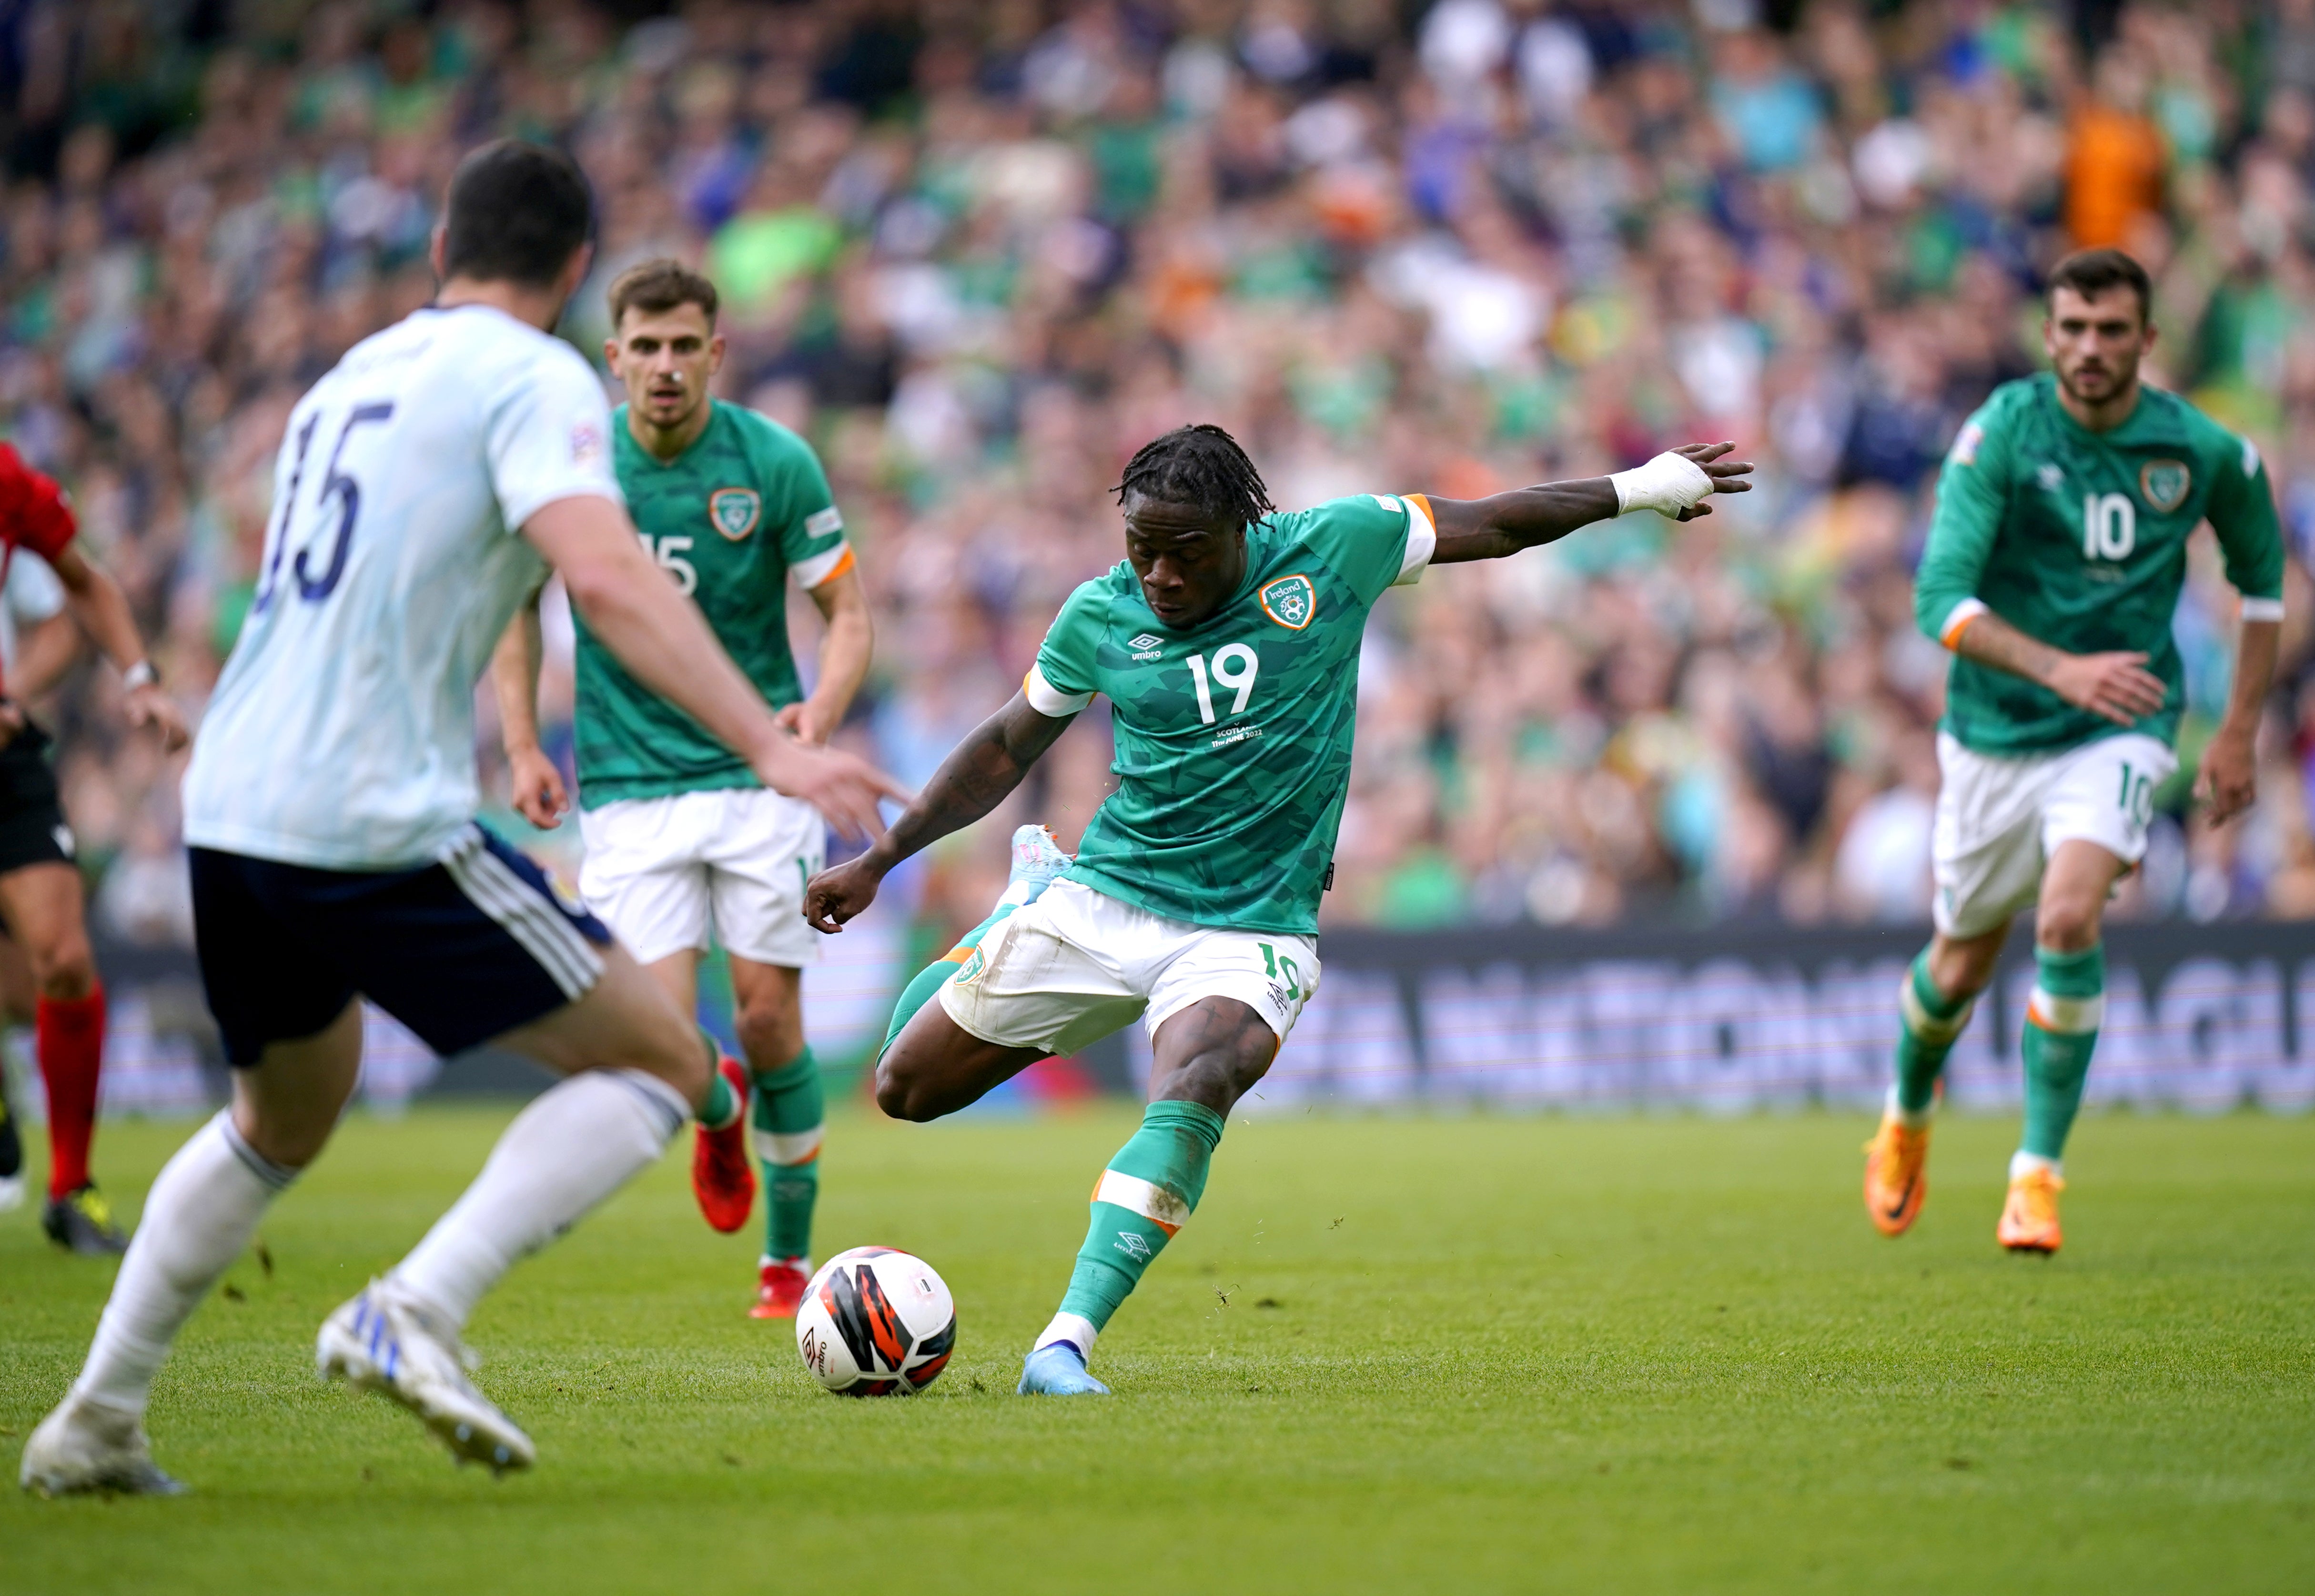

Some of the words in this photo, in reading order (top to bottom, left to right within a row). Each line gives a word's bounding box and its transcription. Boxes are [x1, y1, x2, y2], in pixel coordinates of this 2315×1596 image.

[257, 403, 394, 614] 15
[2083, 492, 2136, 560] 10
[1268, 580, 1301, 600] Ireland
[1132, 650, 1162, 660] umbro
[1185, 643, 1259, 724] 19
[1225, 733, 1245, 745] JUNE
[1245, 729, 1263, 739] 2022
[1257, 942, 1300, 1001] 19
[1267, 991, 1284, 1017] umbro
[1113, 1242, 1142, 1264] umbro
[817, 1341, 827, 1378] umbro
